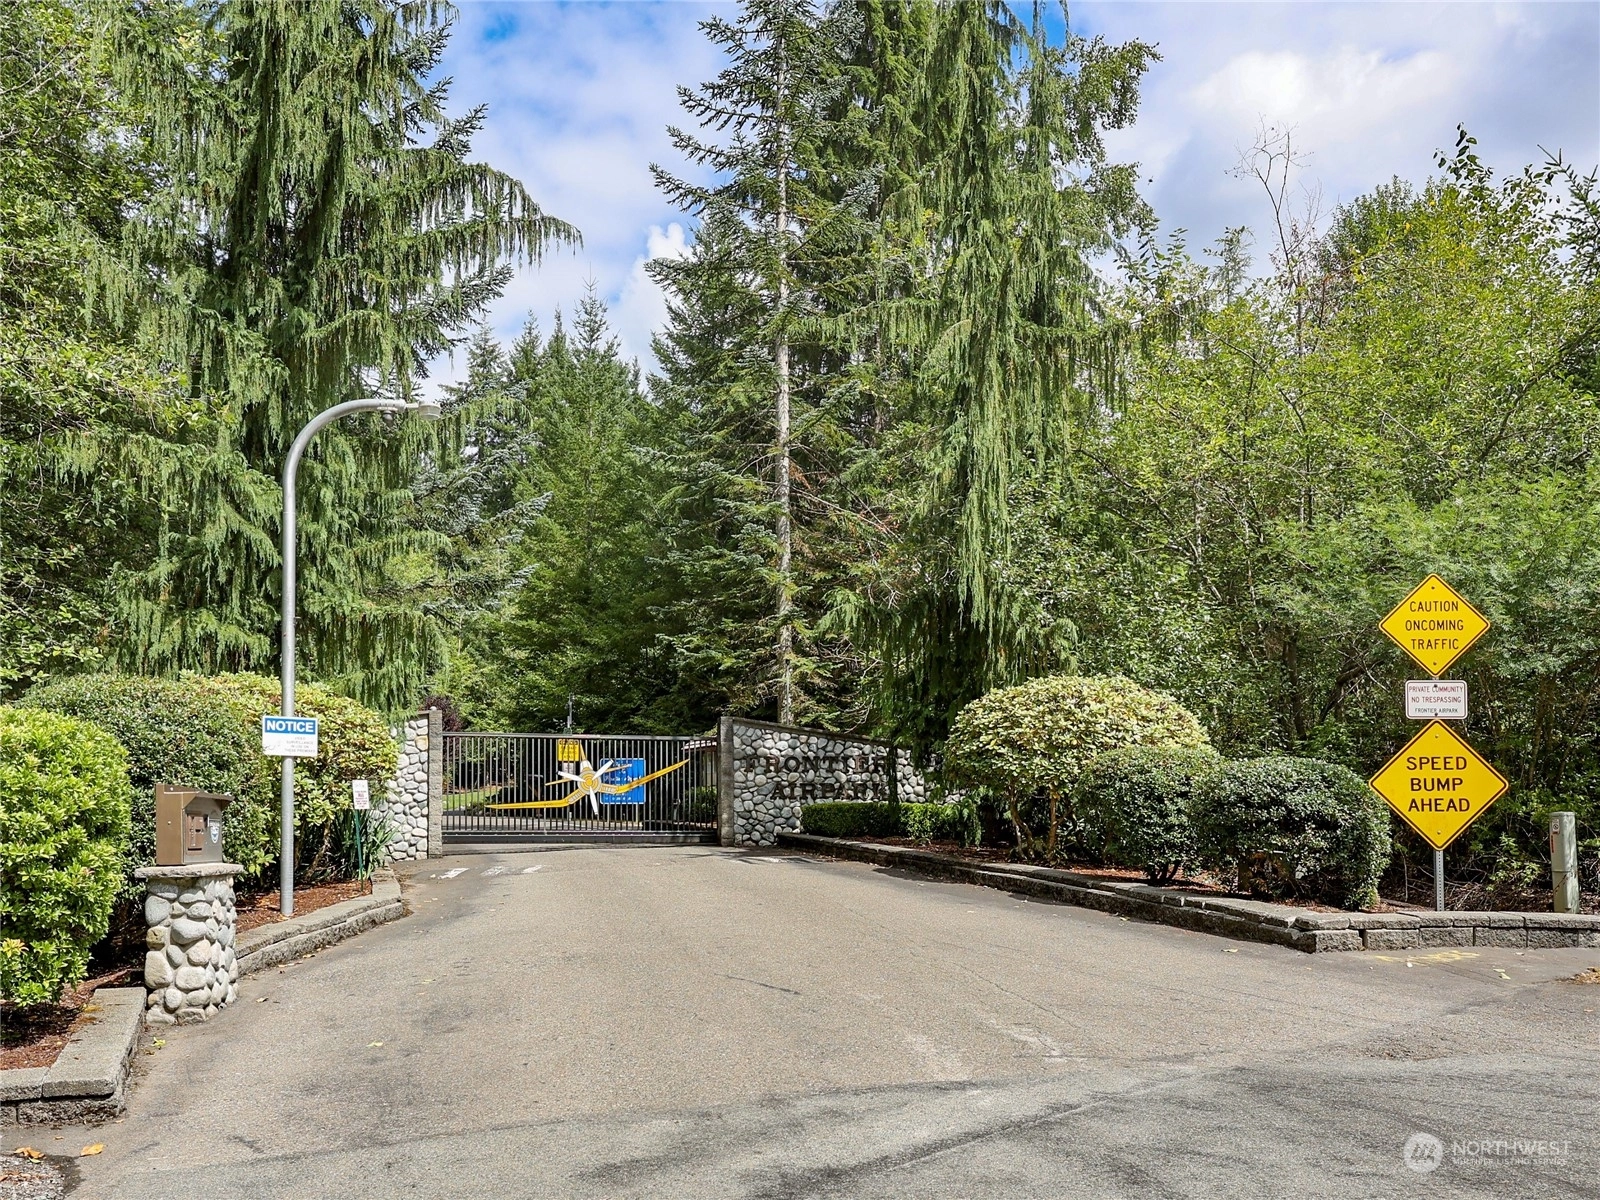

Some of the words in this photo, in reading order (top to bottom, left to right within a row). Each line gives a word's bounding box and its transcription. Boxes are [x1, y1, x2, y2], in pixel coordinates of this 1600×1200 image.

[1409, 600, 1459, 612] CAUTION
[1405, 619, 1464, 631] ONCOMING
[1411, 638, 1459, 650] TRAFFIC
[1432, 685, 1463, 693] COMMUNITY
[266, 719, 315, 733] NOTICE
[1406, 756, 1467, 771] SPEED
[1410, 777, 1463, 792] BUMP
[1407, 797, 1470, 812] AHEAD
